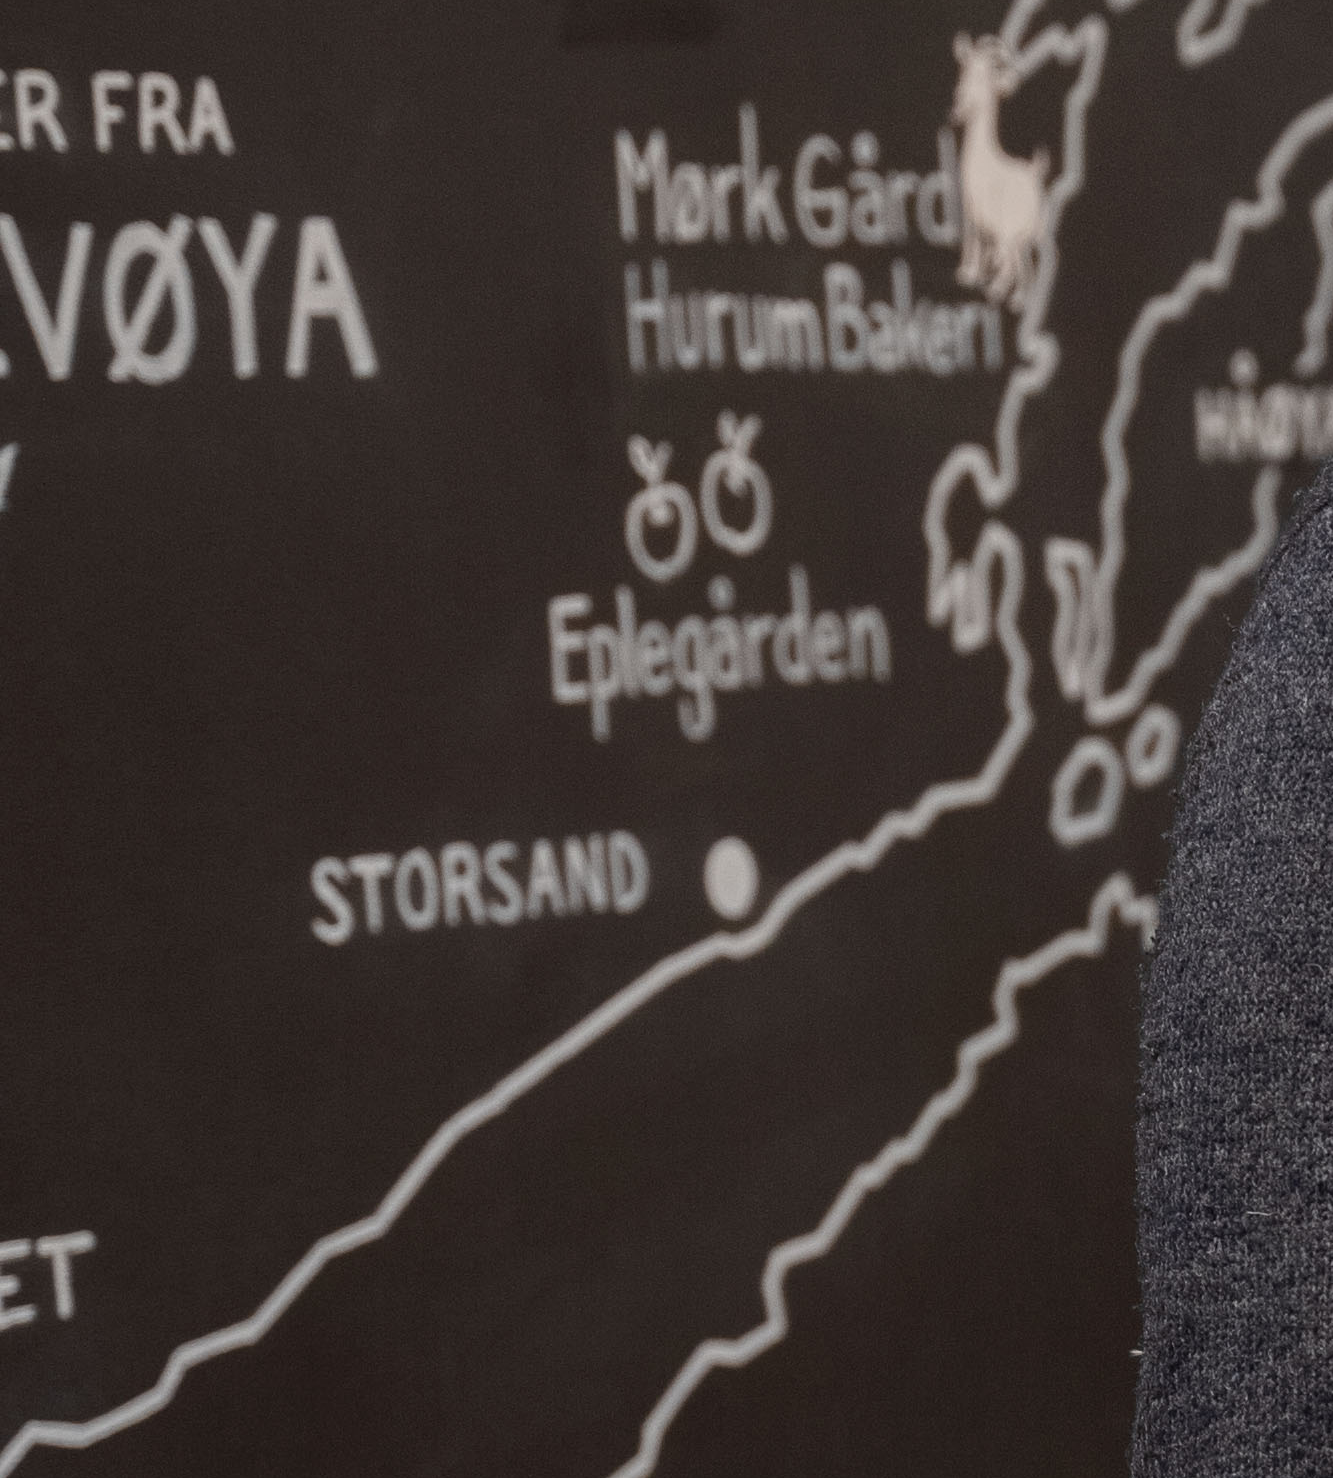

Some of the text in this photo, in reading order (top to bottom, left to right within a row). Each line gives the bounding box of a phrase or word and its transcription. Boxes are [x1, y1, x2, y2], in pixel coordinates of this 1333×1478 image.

[90, 69, 236, 156] FRA
[793, 128, 961, 249] Gård
[0, 211, 380, 386] VØYA
[623, 257, 1002, 377] Hurum Bakeri
[546, 564, 892, 743] Eplegården
[309, 829, 651, 947] STORSAND
